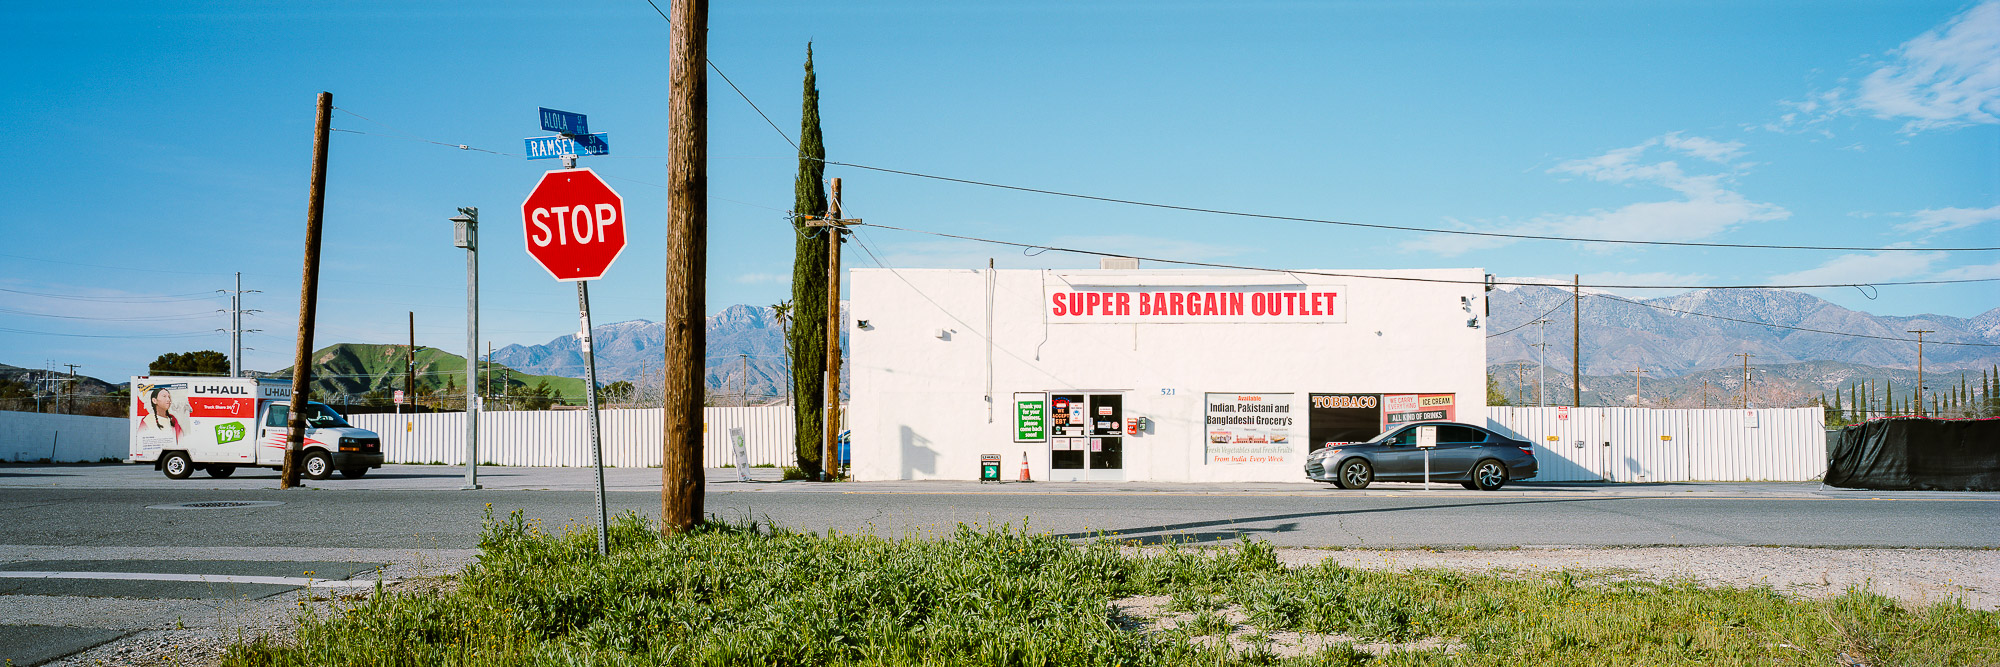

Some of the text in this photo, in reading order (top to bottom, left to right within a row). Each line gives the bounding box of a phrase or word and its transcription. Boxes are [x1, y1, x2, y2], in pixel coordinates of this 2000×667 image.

[544, 111, 568, 130] ALOLA
[589, 135, 596, 144] ST
[530, 138, 575, 156] RAMSEY
[584, 144, 604, 155] 500 E
[531, 203, 617, 248] STOP
[1052, 292, 1337, 316] SUPER BARGAIN OUTLET
[194, 385, 248, 395] U-HAUL
[264, 387, 293, 397] U-HAU
[1161, 388, 1176, 396] 521
[1312, 395, 1377, 409] TOBBACO
[1398, 396, 1414, 404] CARRY
[1422, 397, 1451, 406] ICE CREAM
[1210, 402, 1290, 413] Indian, Pakistani and
[1387, 402, 1417, 411] EVERYTHING
[1206, 415, 1293, 427] Bangladeshi Grocery's
[1392, 411, 1443, 422] ALL KIND OF DRINKS
[1221, 446, 1250, 455] Vegetables
[1250, 446, 1263, 454] and
[1214, 455, 1284, 464] From India Every Week
